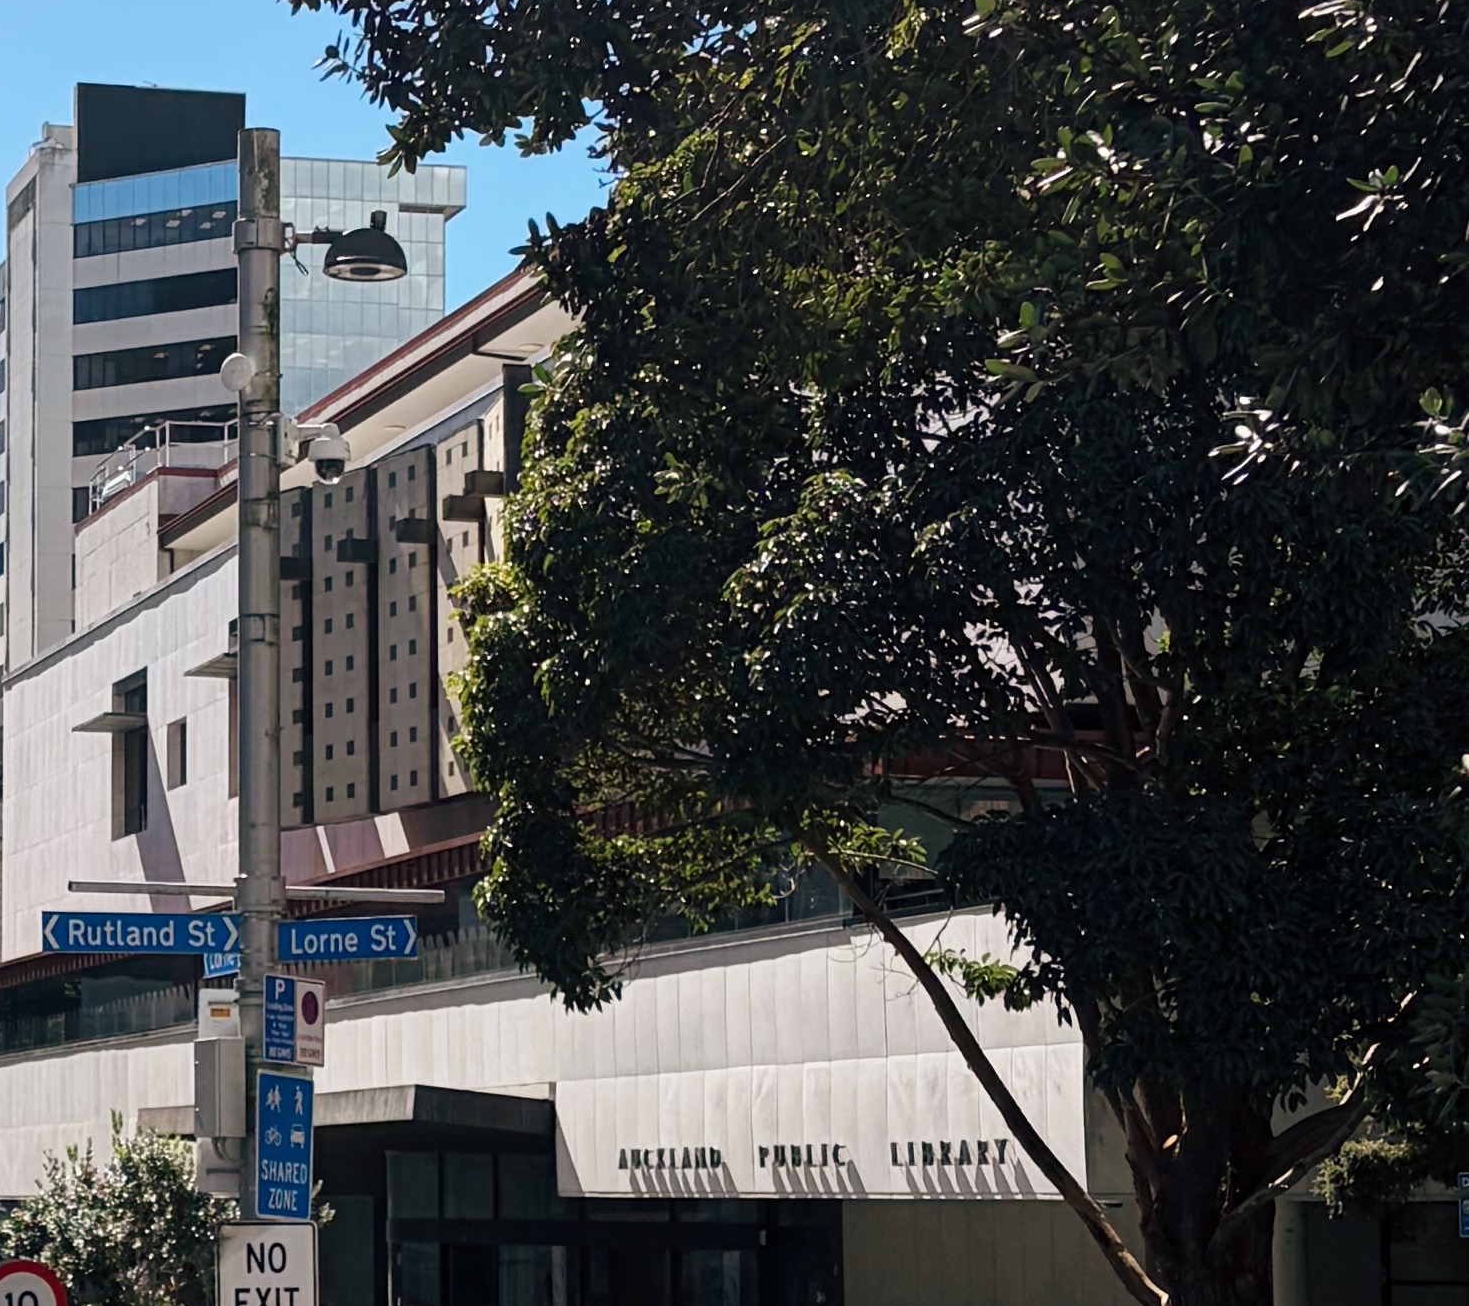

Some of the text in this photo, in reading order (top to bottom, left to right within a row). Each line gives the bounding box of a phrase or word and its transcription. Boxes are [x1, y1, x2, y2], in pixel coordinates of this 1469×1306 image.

[68, 918, 216, 948] Rutland St
[291, 923, 397, 956] Lorne St
[275, 978, 286, 1001] P
[618, 1138, 1009, 1170] AUCKLAND PUBLIC LIBRARY
[260, 1158, 308, 1186] SHARED
[268, 1188, 299, 1212] ZONE
[245, 1242, 287, 1274] NO
